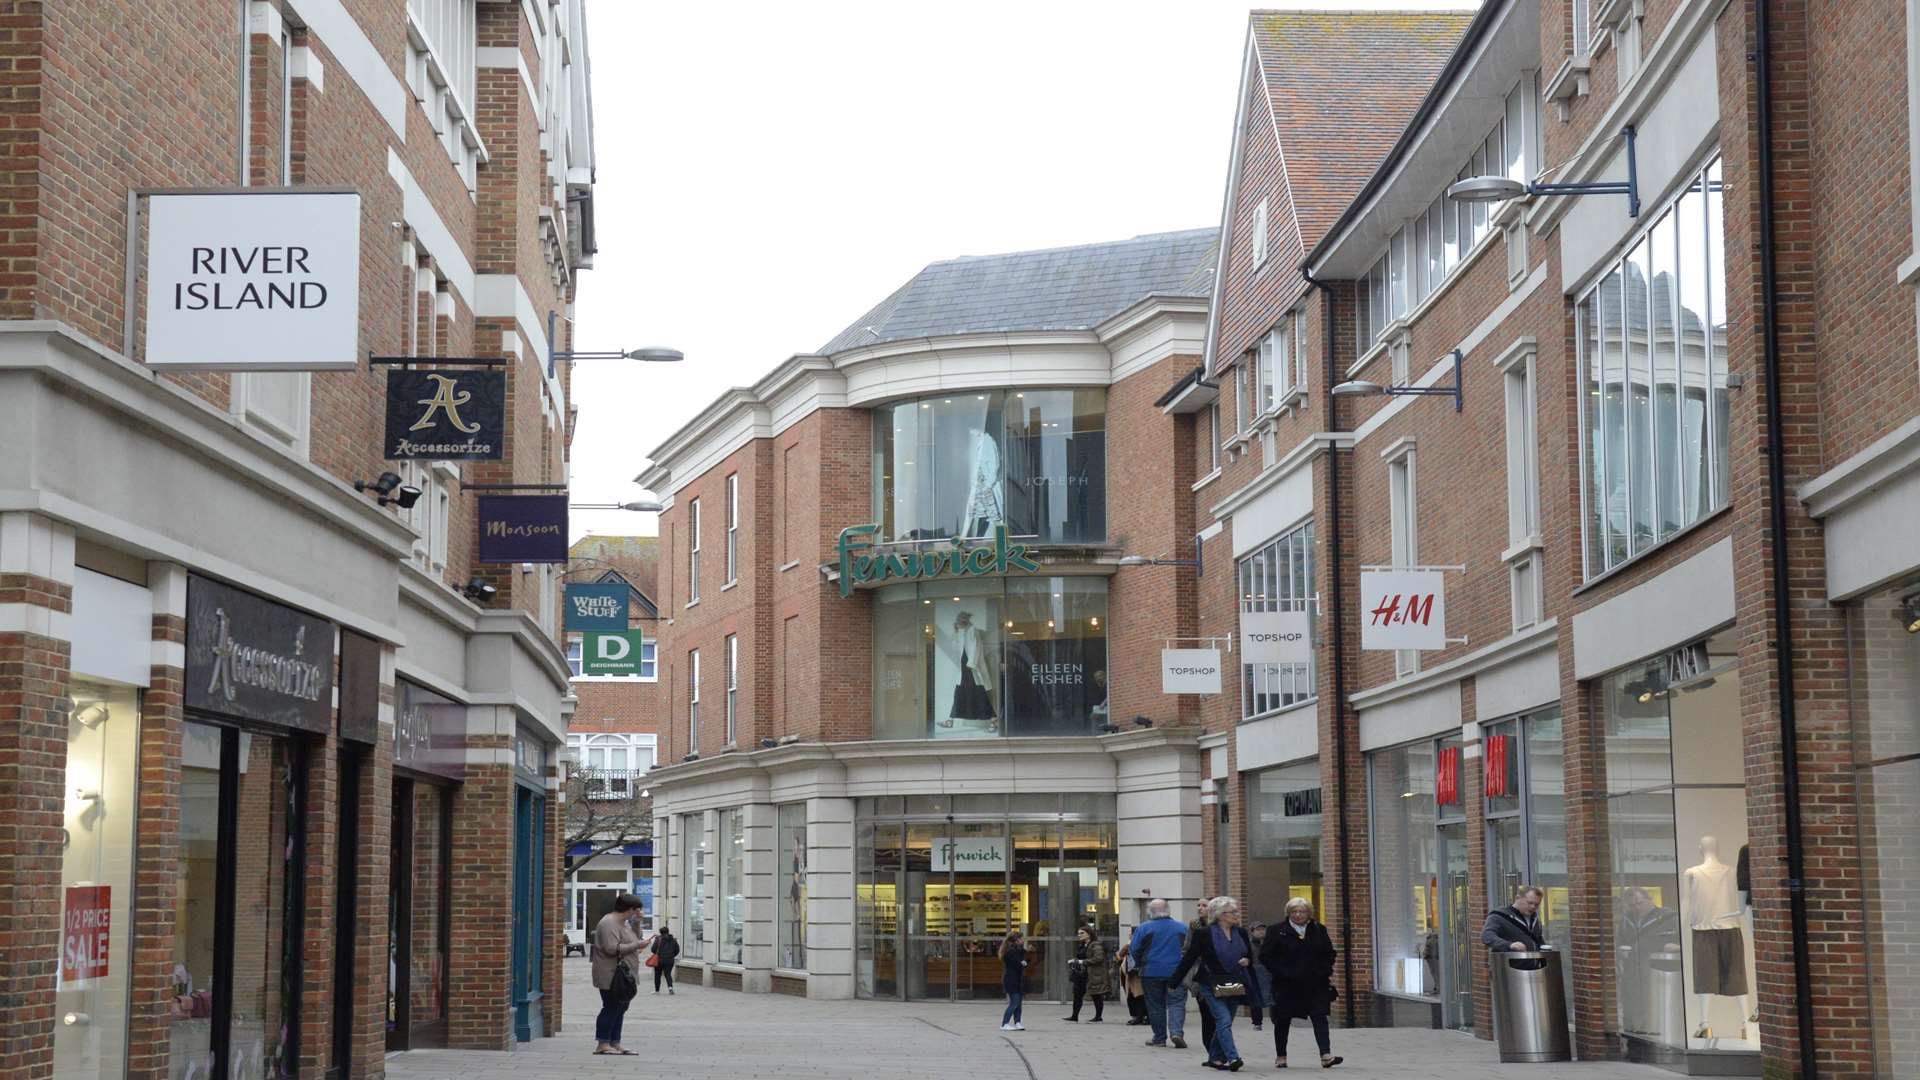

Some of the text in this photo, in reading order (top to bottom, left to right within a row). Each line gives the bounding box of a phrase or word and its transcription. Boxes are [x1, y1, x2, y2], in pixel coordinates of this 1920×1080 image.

[192, 247, 311, 275] RIVER
[175, 282, 328, 311] ISLAND
[409, 373, 481, 434] A
[394, 437, 491, 455] Accessorize
[1024, 476, 1089, 488] JOSEPH
[487, 521, 561, 538] Monsoon
[834, 523, 1041, 599] Fenwick
[1370, 593, 1434, 627] H&M
[597, 635, 631, 661] D
[1248, 633, 1303, 643] TOPSHOP
[208, 607, 323, 702] Accessorize
[1031, 663, 1084, 673] EILEEN
[1031, 674, 1084, 685] FISHER
[1170, 667, 1216, 676] TOPSHOP
[1281, 788, 1322, 816] TOPMAN
[940, 843, 1002, 865] Fnwick
[66, 907, 110, 931] 1/2 PRICE
[65, 932, 108, 970] SALE
